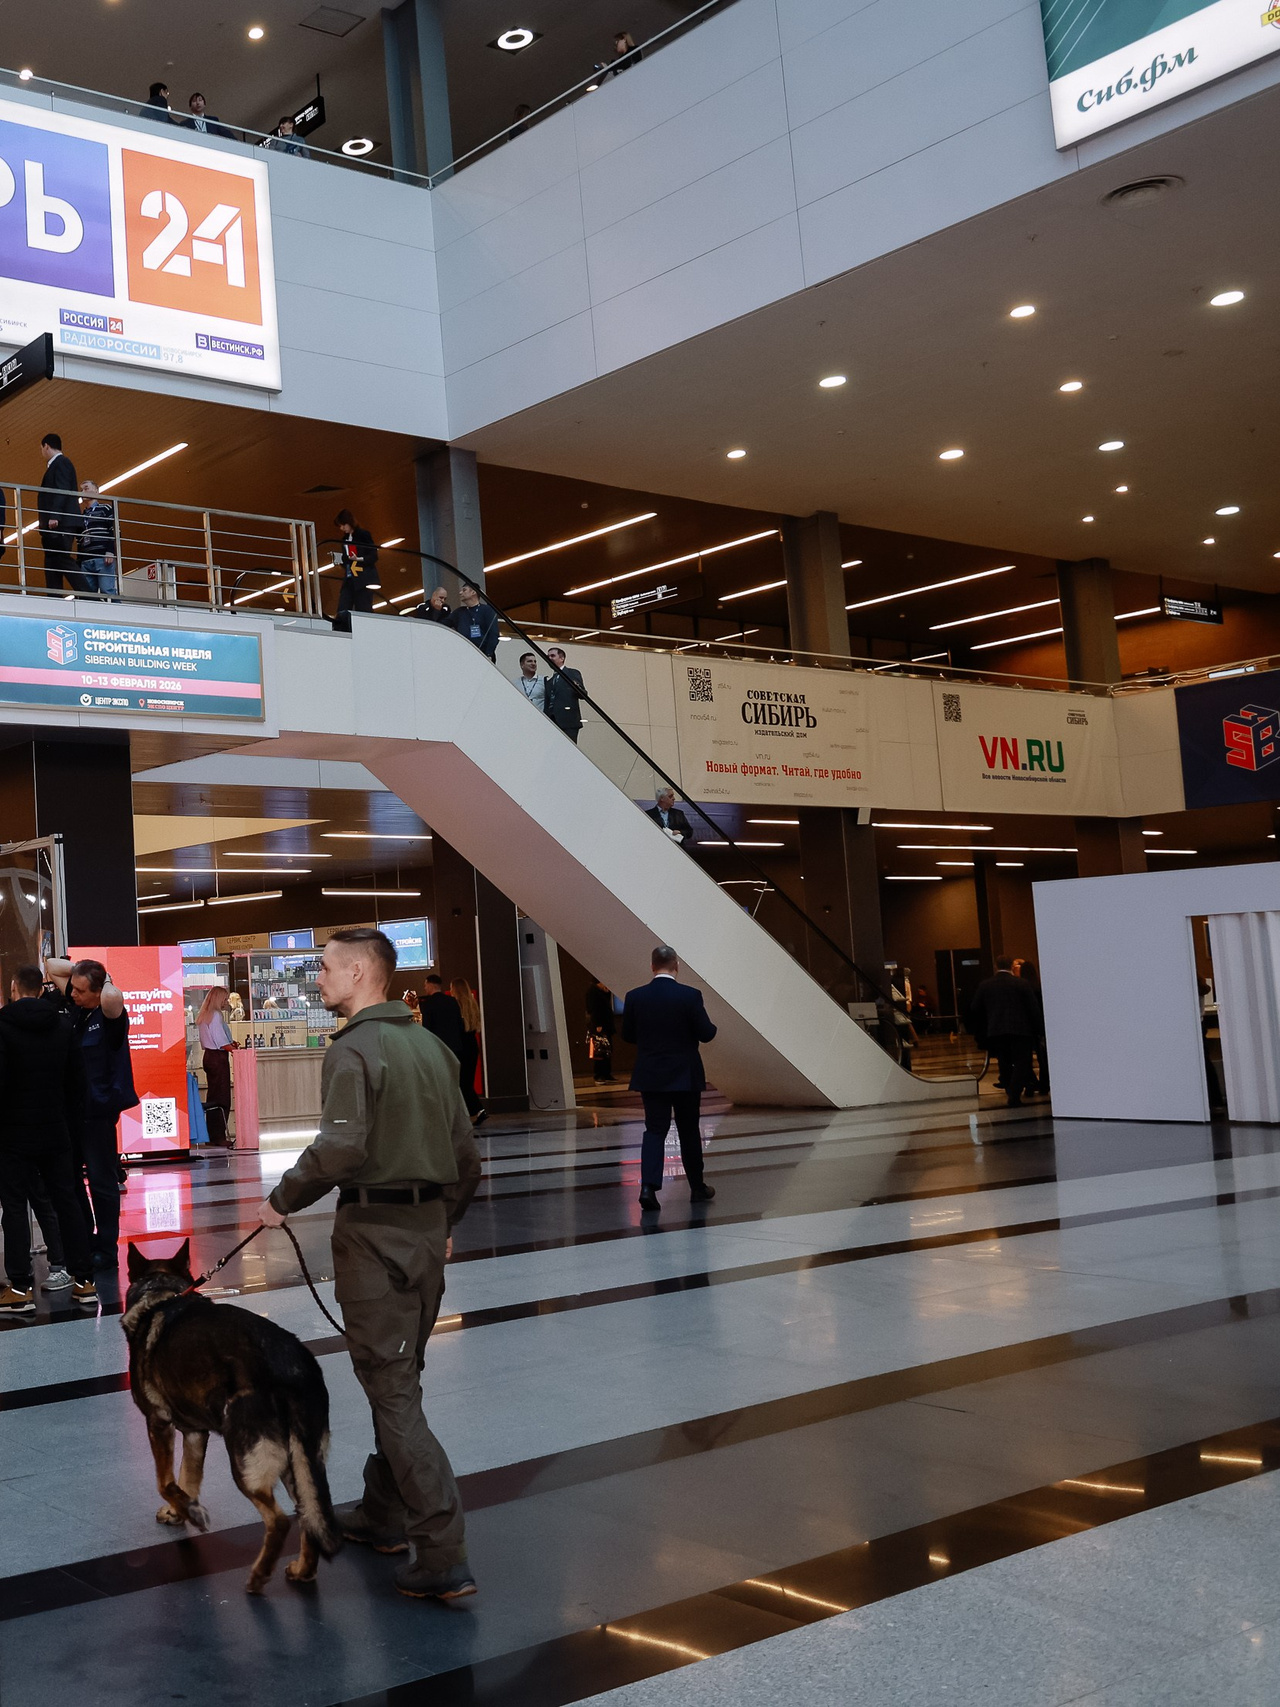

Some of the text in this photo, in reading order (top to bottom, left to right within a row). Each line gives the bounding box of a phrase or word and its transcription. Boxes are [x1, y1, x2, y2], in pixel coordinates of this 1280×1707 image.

[1076, 47, 1198, 112] Сиб.фм
[140, 190, 245, 288] 24
[63, 311, 123, 332] РОССИЯ 24
[211, 340, 264, 357] ВЕСТИНСК.РФ
[164, 352, 184, 364] 97.8
[83, 628, 151, 644] СИБИРСКАЯ
[83, 640, 212, 661] СТРОИТЕЛЬНАЯ НЕДЕЛЯ
[84, 654, 198, 672] SIBERIAN BUILDING WEEK
[110, 676, 157, 689] ФЕВРАЛЯ
[159, 680, 182, 691] 2026
[747, 690, 806, 704] СОВЕТСКАЯ
[741, 702, 817, 728] СИБИРЬ
[754, 729, 794, 737] издательский
[978, 735, 1065, 773] VN.RU
[705, 760, 862, 780] Новый формат. Читай, где удобно
[132, 1003, 173, 1014] центре
